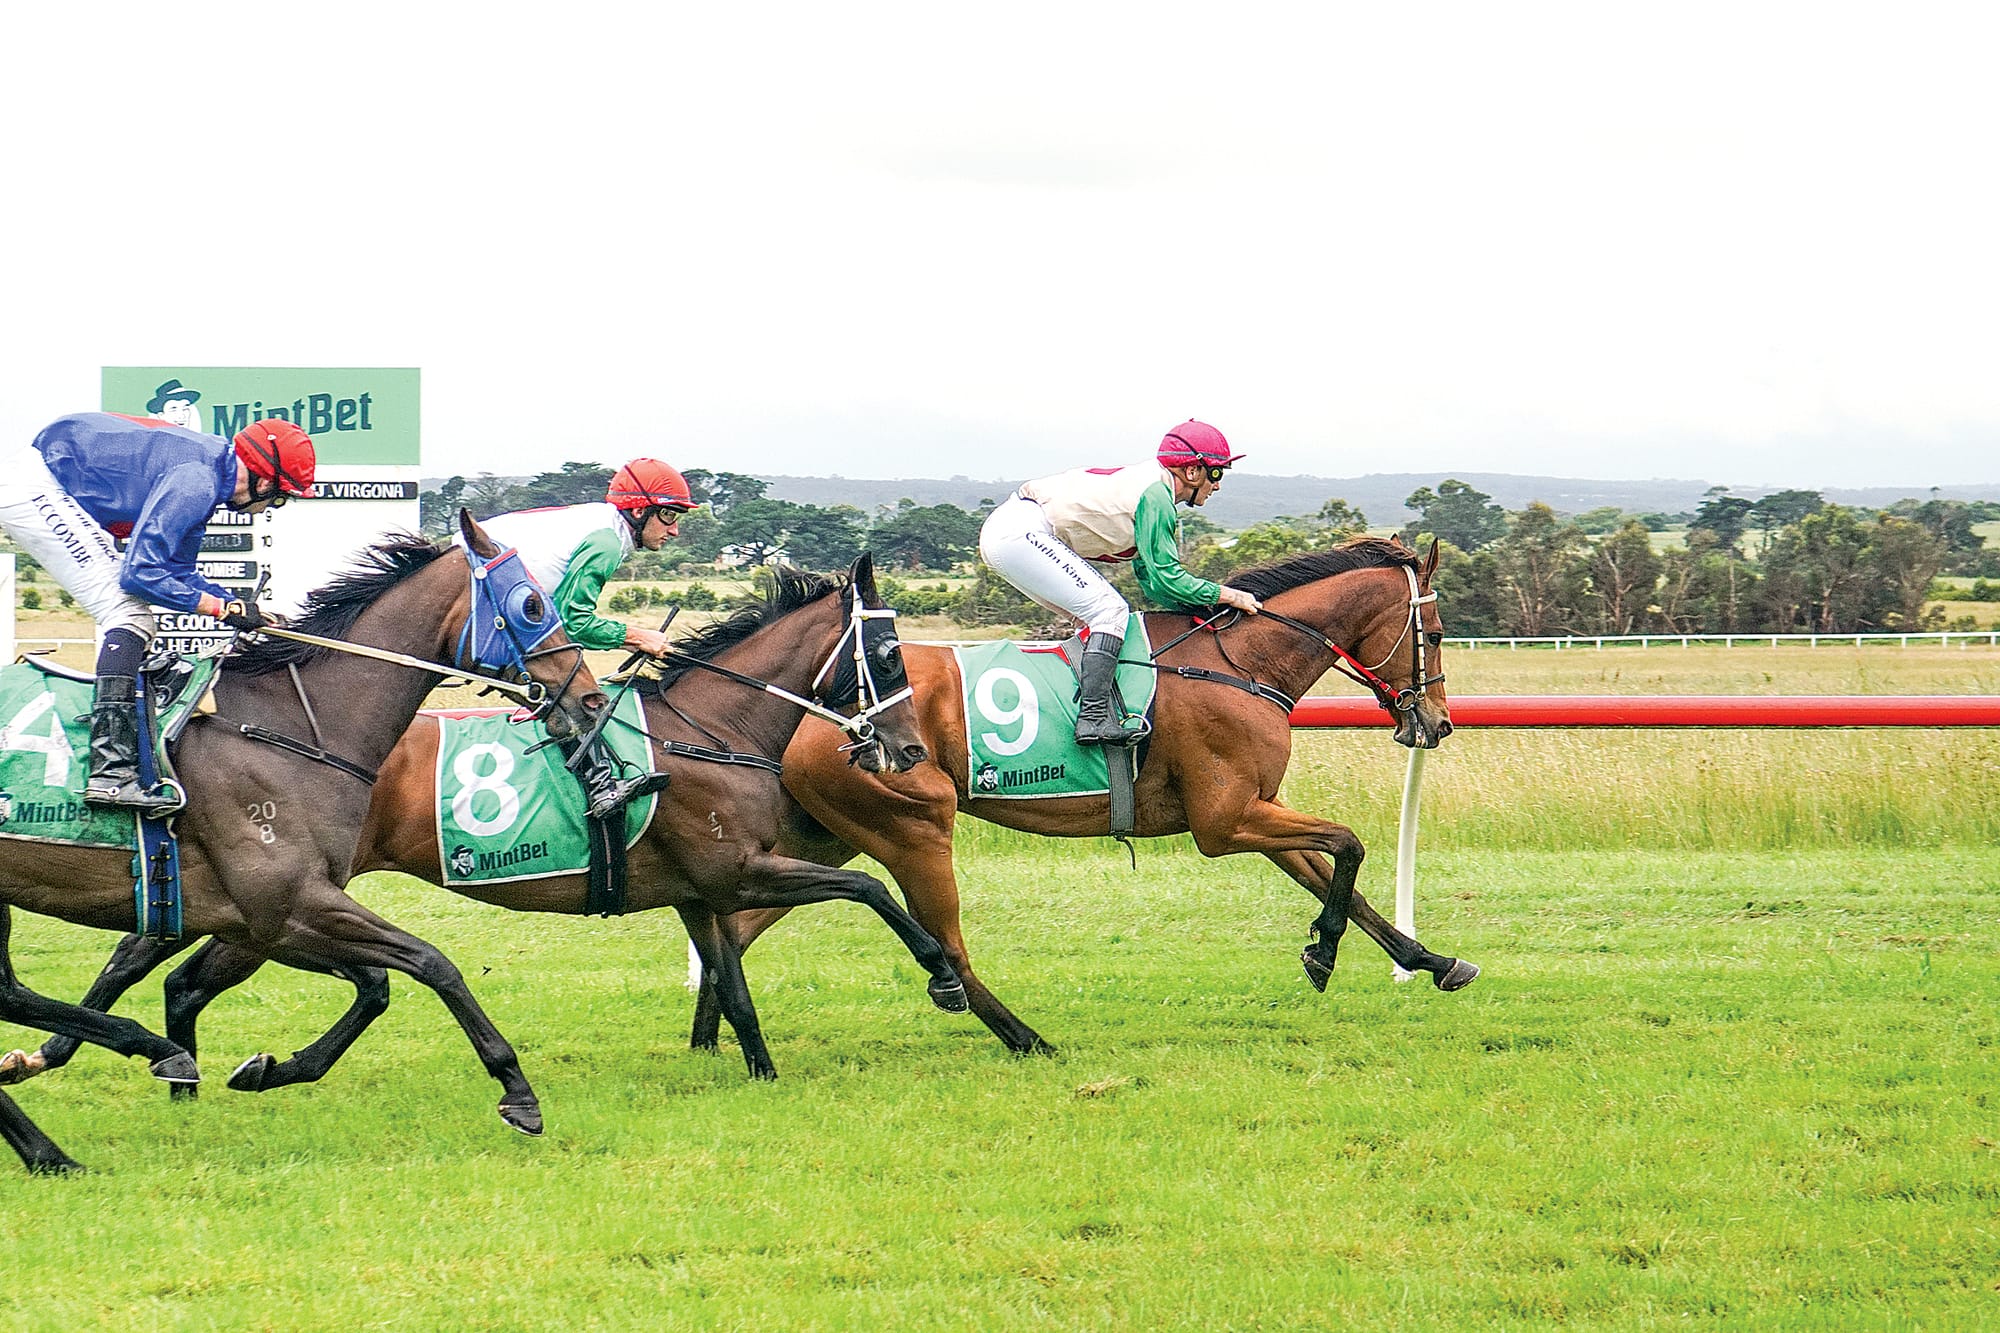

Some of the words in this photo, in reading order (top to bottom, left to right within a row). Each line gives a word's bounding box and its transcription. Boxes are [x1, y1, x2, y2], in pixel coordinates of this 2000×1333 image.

[213, 392, 372, 444] MintBet
[266, 510, 272, 522] 9
[261, 535, 273, 548] 10
[1025, 532, 1061, 564] Caitlin
[1062, 563, 1089, 589] King
[974, 667, 1040, 757] 9
[0, 690, 74, 787] 4
[451, 741, 521, 837] 8
[1002, 763, 1066, 788] MintBet
[16, 801, 96, 823] MintBet
[247, 800, 277, 823] 20
[259, 823, 276, 844] 8
[479, 840, 549, 871] MintBet
